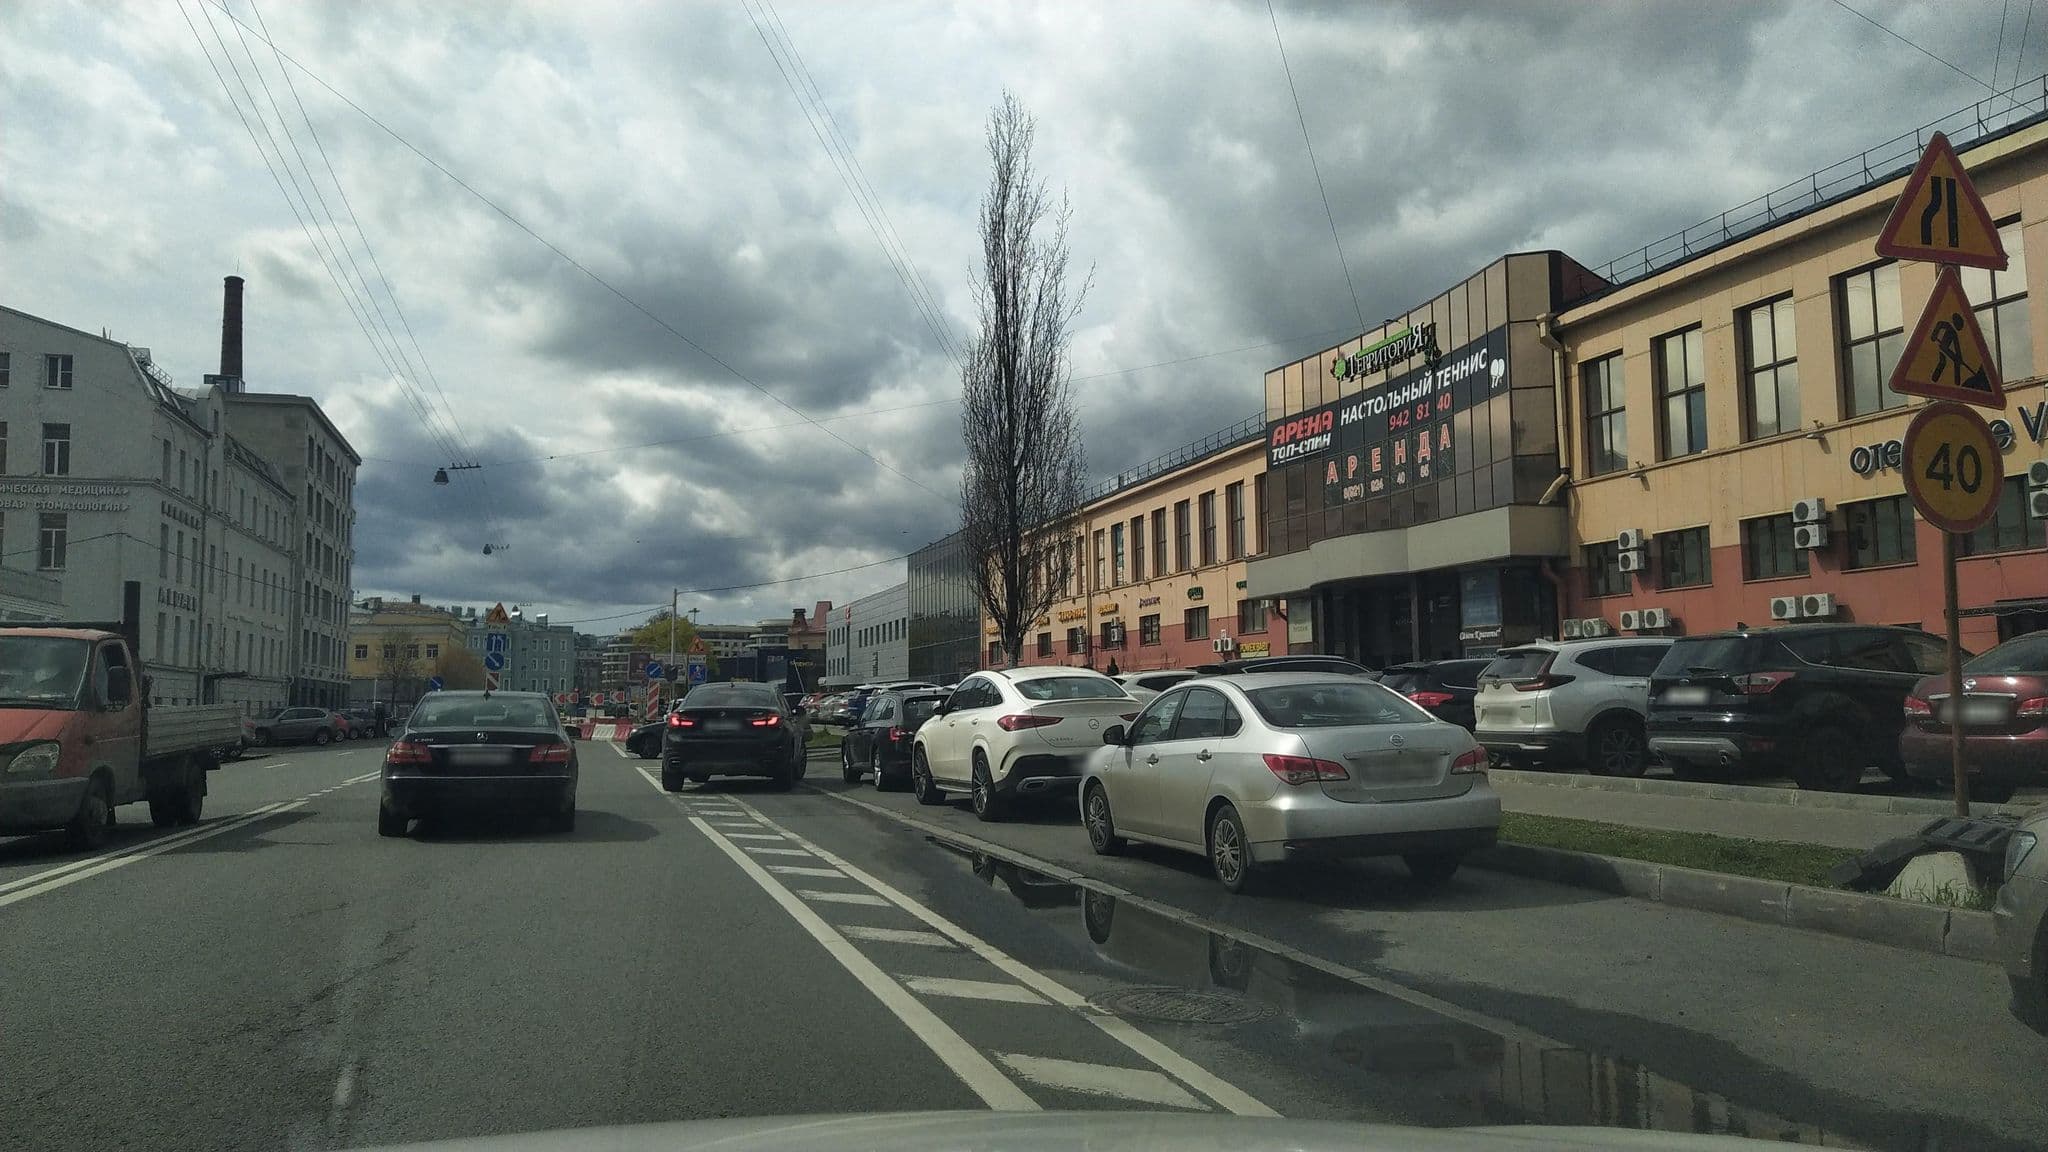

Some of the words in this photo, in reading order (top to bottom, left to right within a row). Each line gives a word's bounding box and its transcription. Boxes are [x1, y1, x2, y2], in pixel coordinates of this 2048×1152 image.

[1340, 370, 1433, 426] НАСТОЛЬНЫЙ
[1436, 348, 1487, 390] ТЕННИС
[1271, 410, 1334, 447] АРЕНА
[1389, 409, 1410, 431] 942
[1416, 401, 1430, 421] 81
[1437, 392, 1451, 412] 40
[1271, 433, 1332, 461] ТОП-СПИН
[1850, 439, 1902, 474] оте
[1925, 442, 1982, 494] 40
[34, 500, 121, 512] СТОМАТОЛОГИЯ
[60, 484, 122, 497] МЕДИЦИНА
